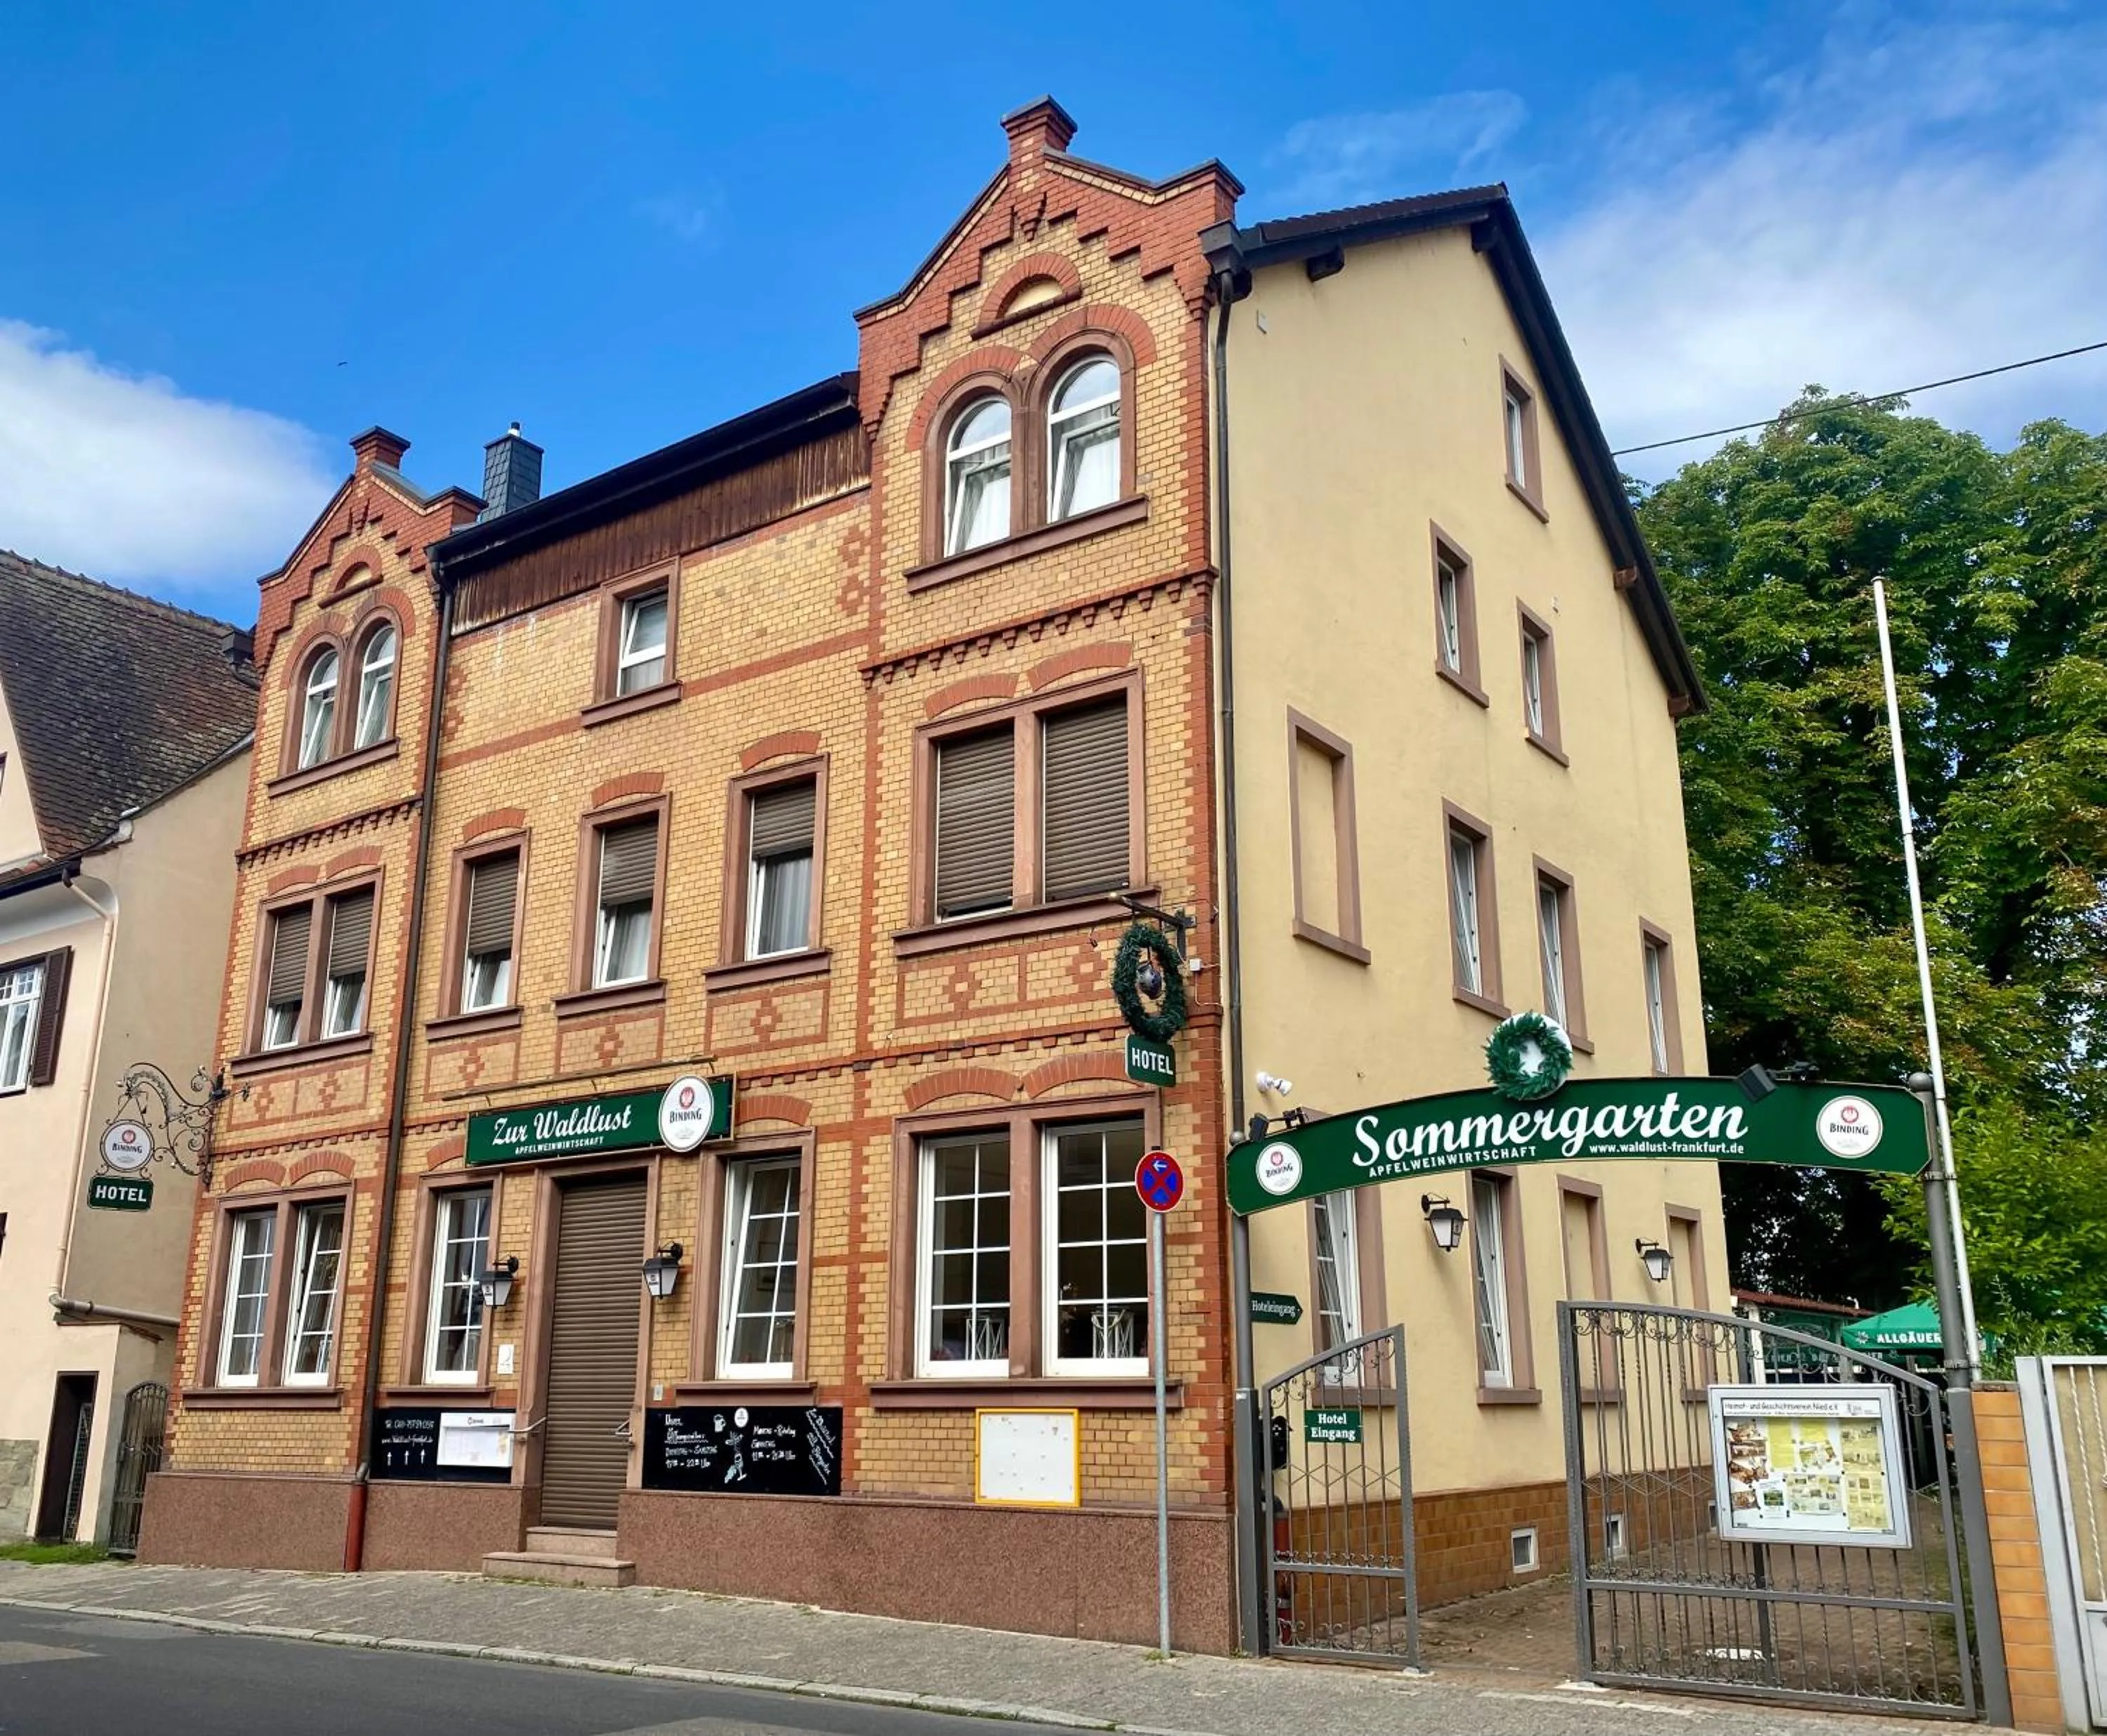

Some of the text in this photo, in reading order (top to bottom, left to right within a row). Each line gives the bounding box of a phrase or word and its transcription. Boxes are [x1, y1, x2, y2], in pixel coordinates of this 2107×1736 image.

[1131, 1047, 1174, 1075] HOTEL
[670, 1107, 702, 1124] BINDING
[492, 1104, 631, 1145] Zur Waldlust
[1352, 1091, 1749, 1167] Sommergarten
[1830, 1122, 1869, 1136] BINDING
[112, 1143, 143, 1154] BINDING
[515, 1136, 605, 1155] APFELWEINWIRTSCHAFT
[1589, 1140, 1745, 1155] www.waldlust-frankfurt.de
[1369, 1145, 1537, 1178] APFELWEINWIRTSCHAFT
[95, 1185, 147, 1202] HOTEL
[1252, 1299, 1297, 1317] Hoteleingang
[1876, 1331, 1943, 1344] ALLGÄUER
[1317, 1413, 1347, 1424] Hotel
[1311, 1427, 1356, 1440] Eingang
